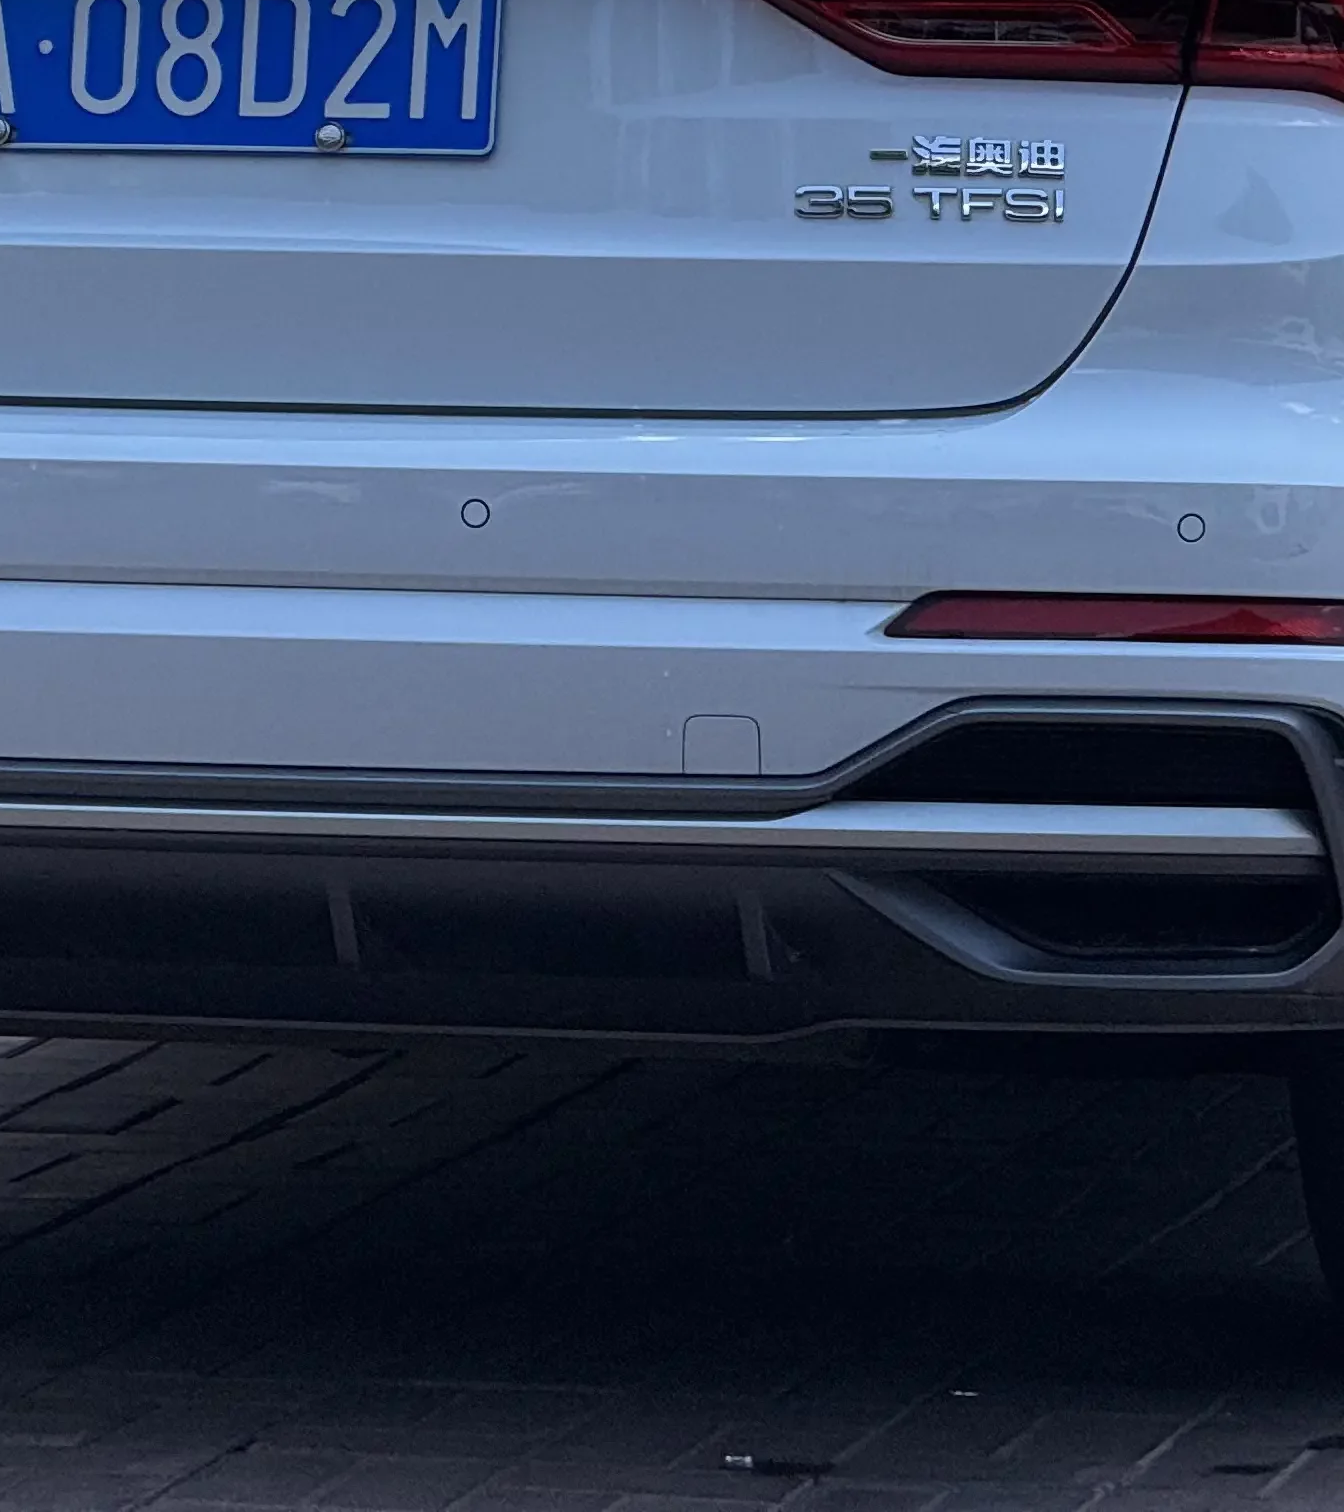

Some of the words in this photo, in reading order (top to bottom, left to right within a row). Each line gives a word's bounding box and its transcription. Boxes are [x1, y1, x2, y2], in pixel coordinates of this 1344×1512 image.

[869, 136, 1065, 178] 一汽奥迪
[794, 185, 894, 219] 35
[912, 187, 1065, 222] TFSI
